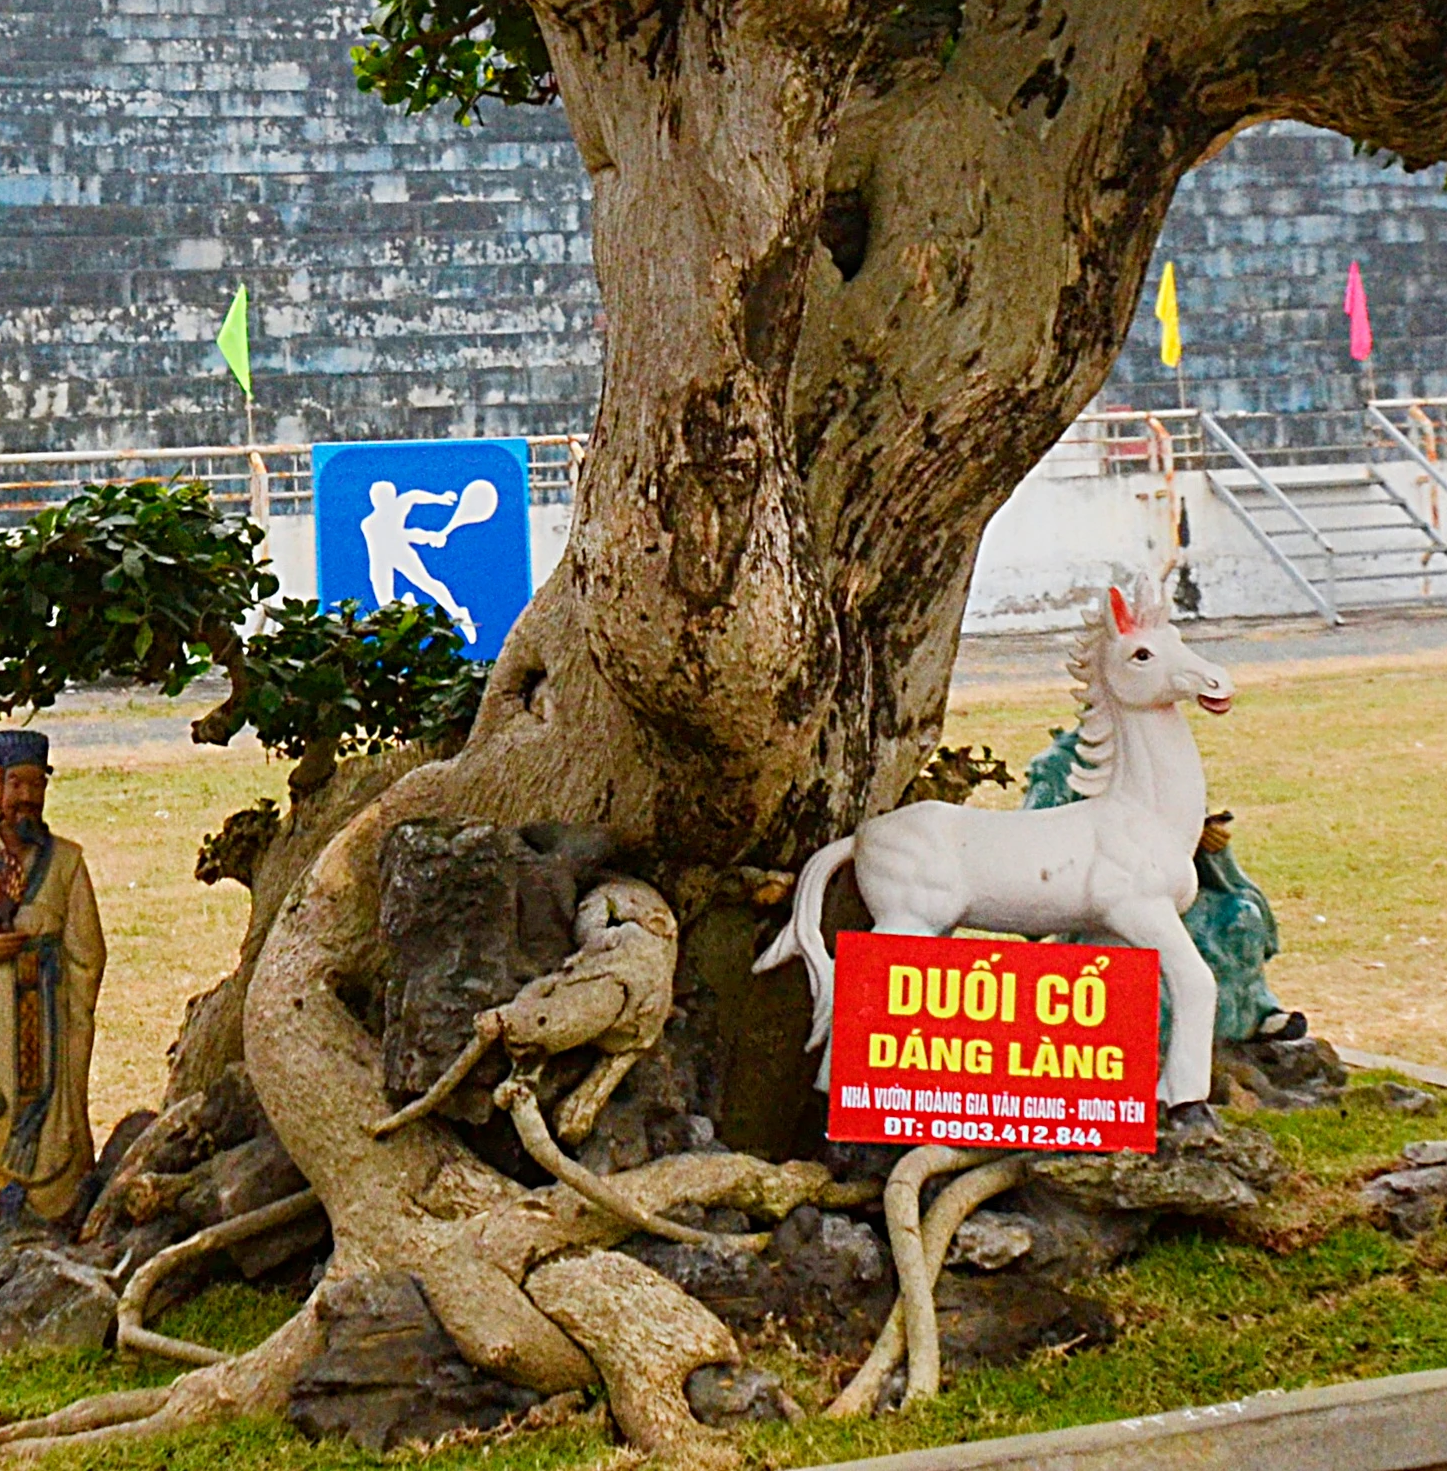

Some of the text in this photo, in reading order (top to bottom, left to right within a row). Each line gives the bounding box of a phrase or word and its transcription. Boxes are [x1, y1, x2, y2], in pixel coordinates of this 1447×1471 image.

[888, 953, 1110, 1027] DUỐI CỔ
[869, 1028, 1124, 1080] DÁNG LÀNG
[841, 1082, 871, 1109] NHÀ
[915, 1086, 962, 1114] HOÀNG
[966, 1092, 989, 1116] GIA
[1023, 1096, 1066, 1120] GIANG
[1119, 1096, 1146, 1123] YÊN
[884, 1116, 1102, 1146] ĐT: 0903.412.844
